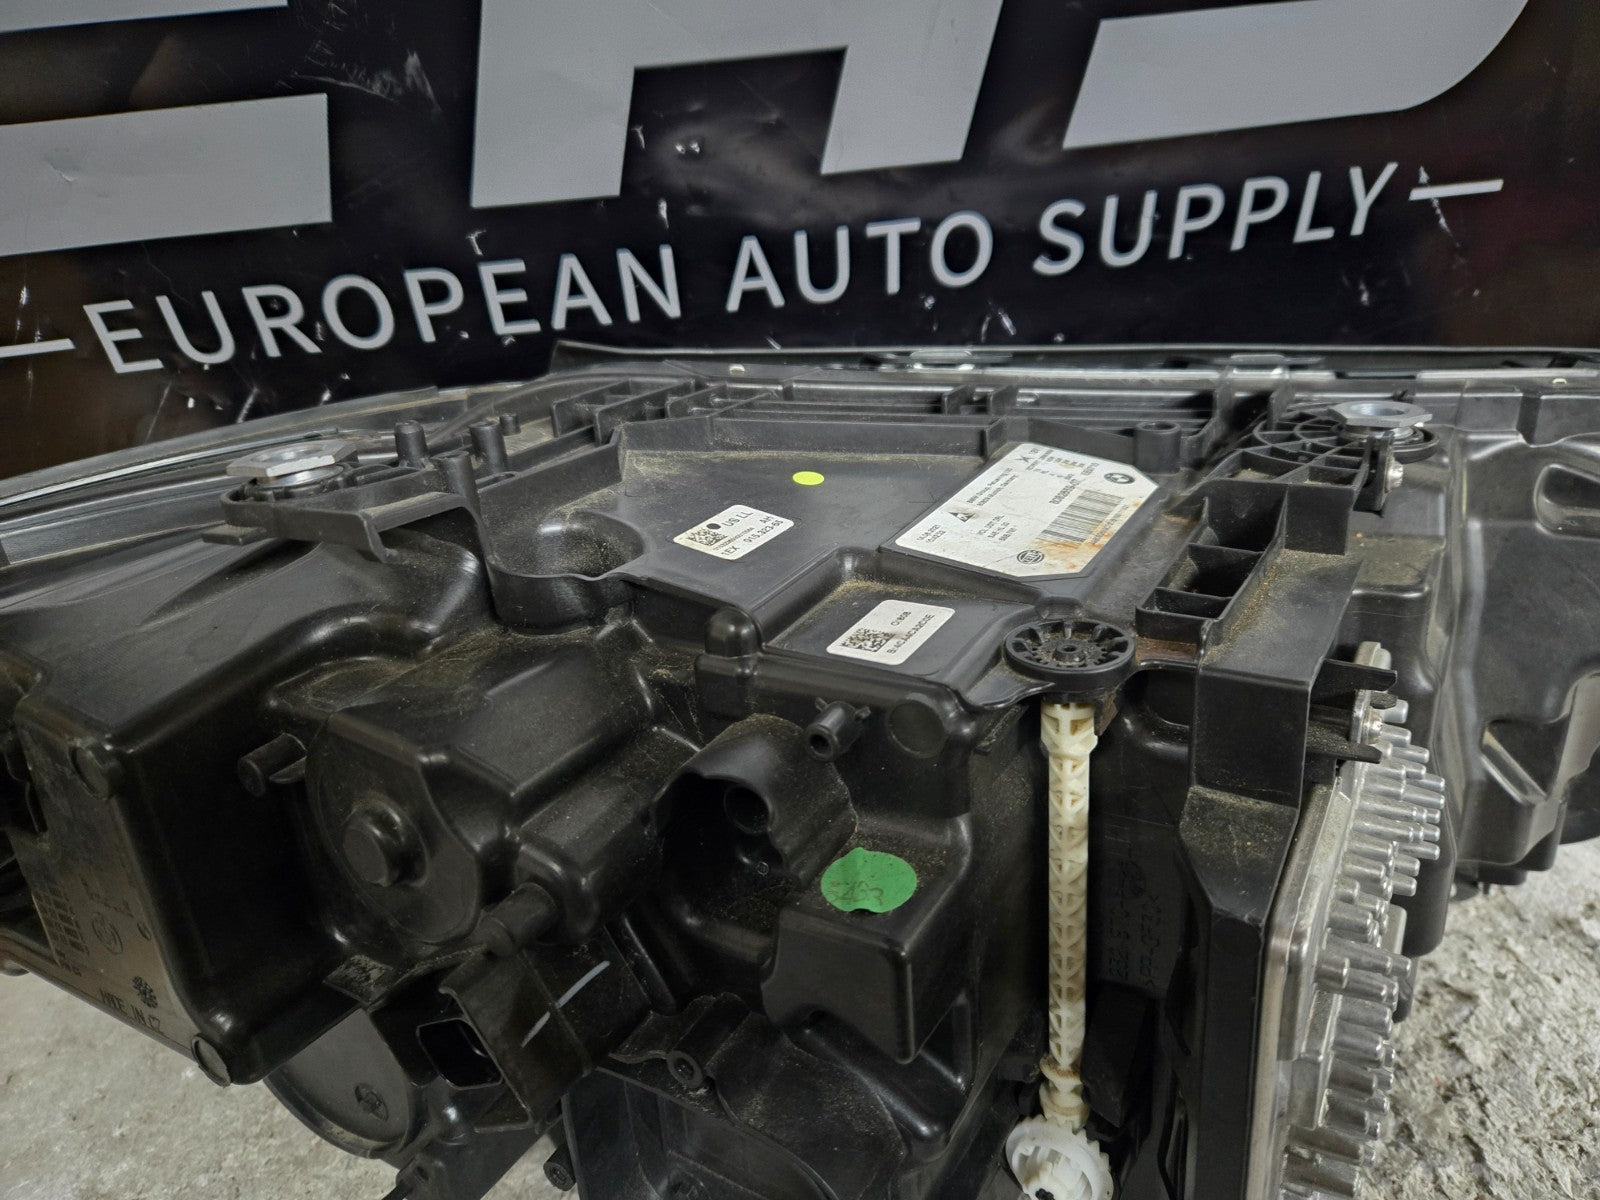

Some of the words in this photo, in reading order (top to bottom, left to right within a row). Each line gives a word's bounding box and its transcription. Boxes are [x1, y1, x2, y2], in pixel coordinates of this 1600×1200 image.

[83, 245, 681, 374] EUROPEAN
[726, 211, 994, 312] AUTO
[1033, 162, 1398, 276] SUPPLY
[722, 517, 741, 527] US
